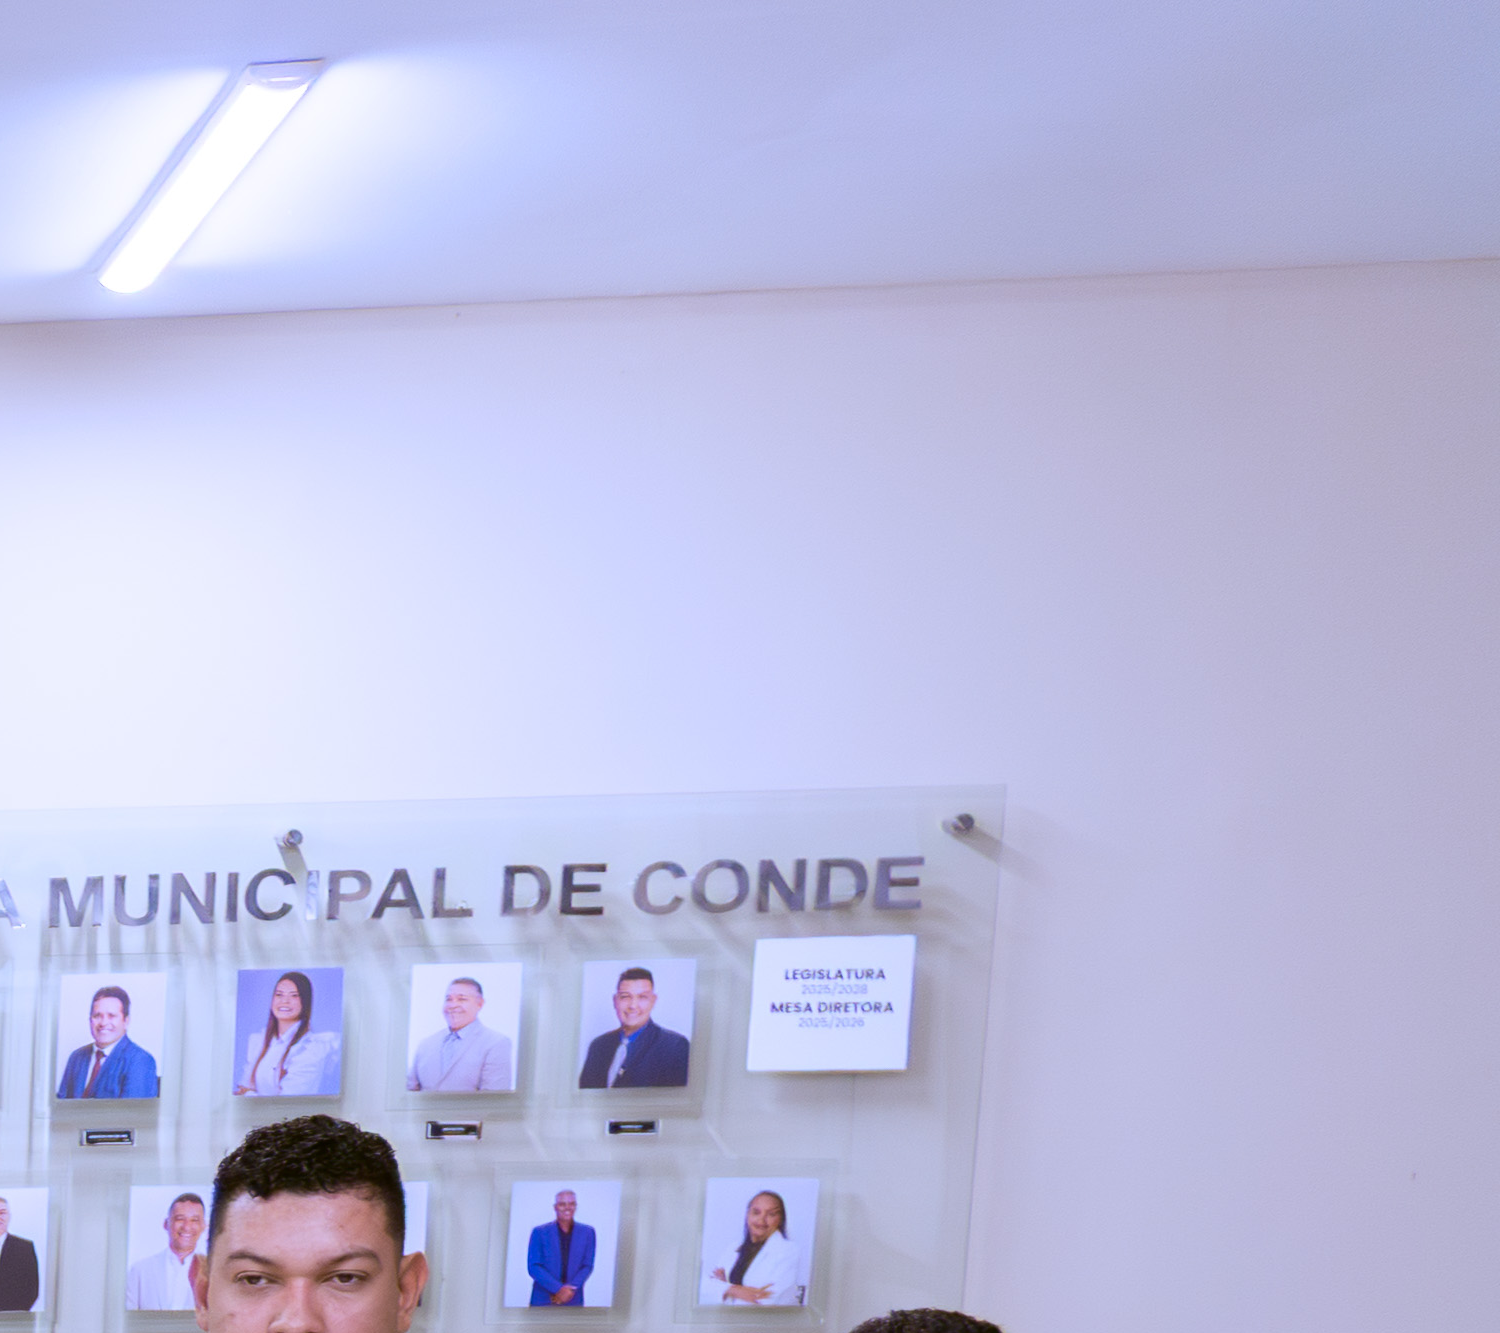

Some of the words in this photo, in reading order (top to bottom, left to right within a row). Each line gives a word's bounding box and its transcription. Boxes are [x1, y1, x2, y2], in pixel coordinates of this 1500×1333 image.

[47, 867, 474, 929] MUNICIPAL
[499, 863, 607, 918] DE
[633, 855, 926, 917] CONDE
[784, 968, 886, 981] LEGISLATURA
[770, 1001, 813, 1014] MESA
[817, 1001, 894, 1014] DIRETORA
